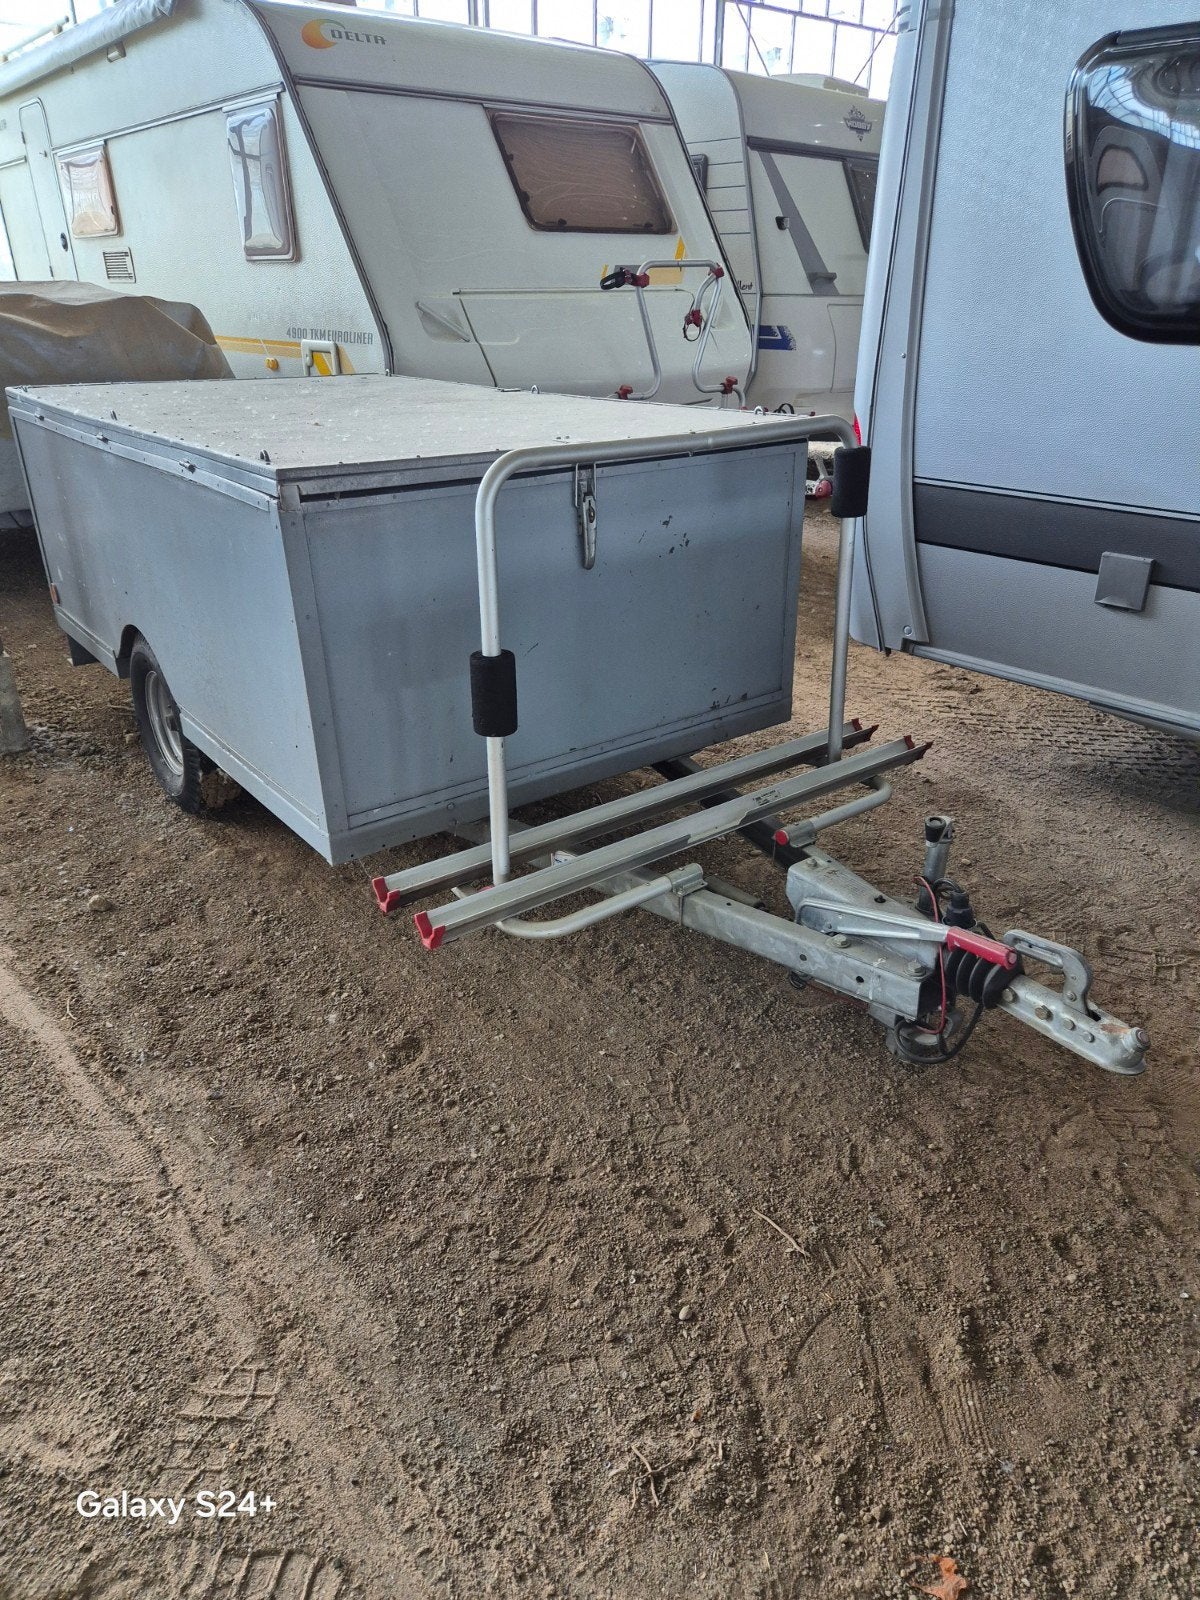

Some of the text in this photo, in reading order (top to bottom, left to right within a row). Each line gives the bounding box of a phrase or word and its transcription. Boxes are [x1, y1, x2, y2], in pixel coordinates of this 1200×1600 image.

[330, 29, 387, 45] DELTA
[286, 327, 374, 345] 4900 TKM EUROLINER
